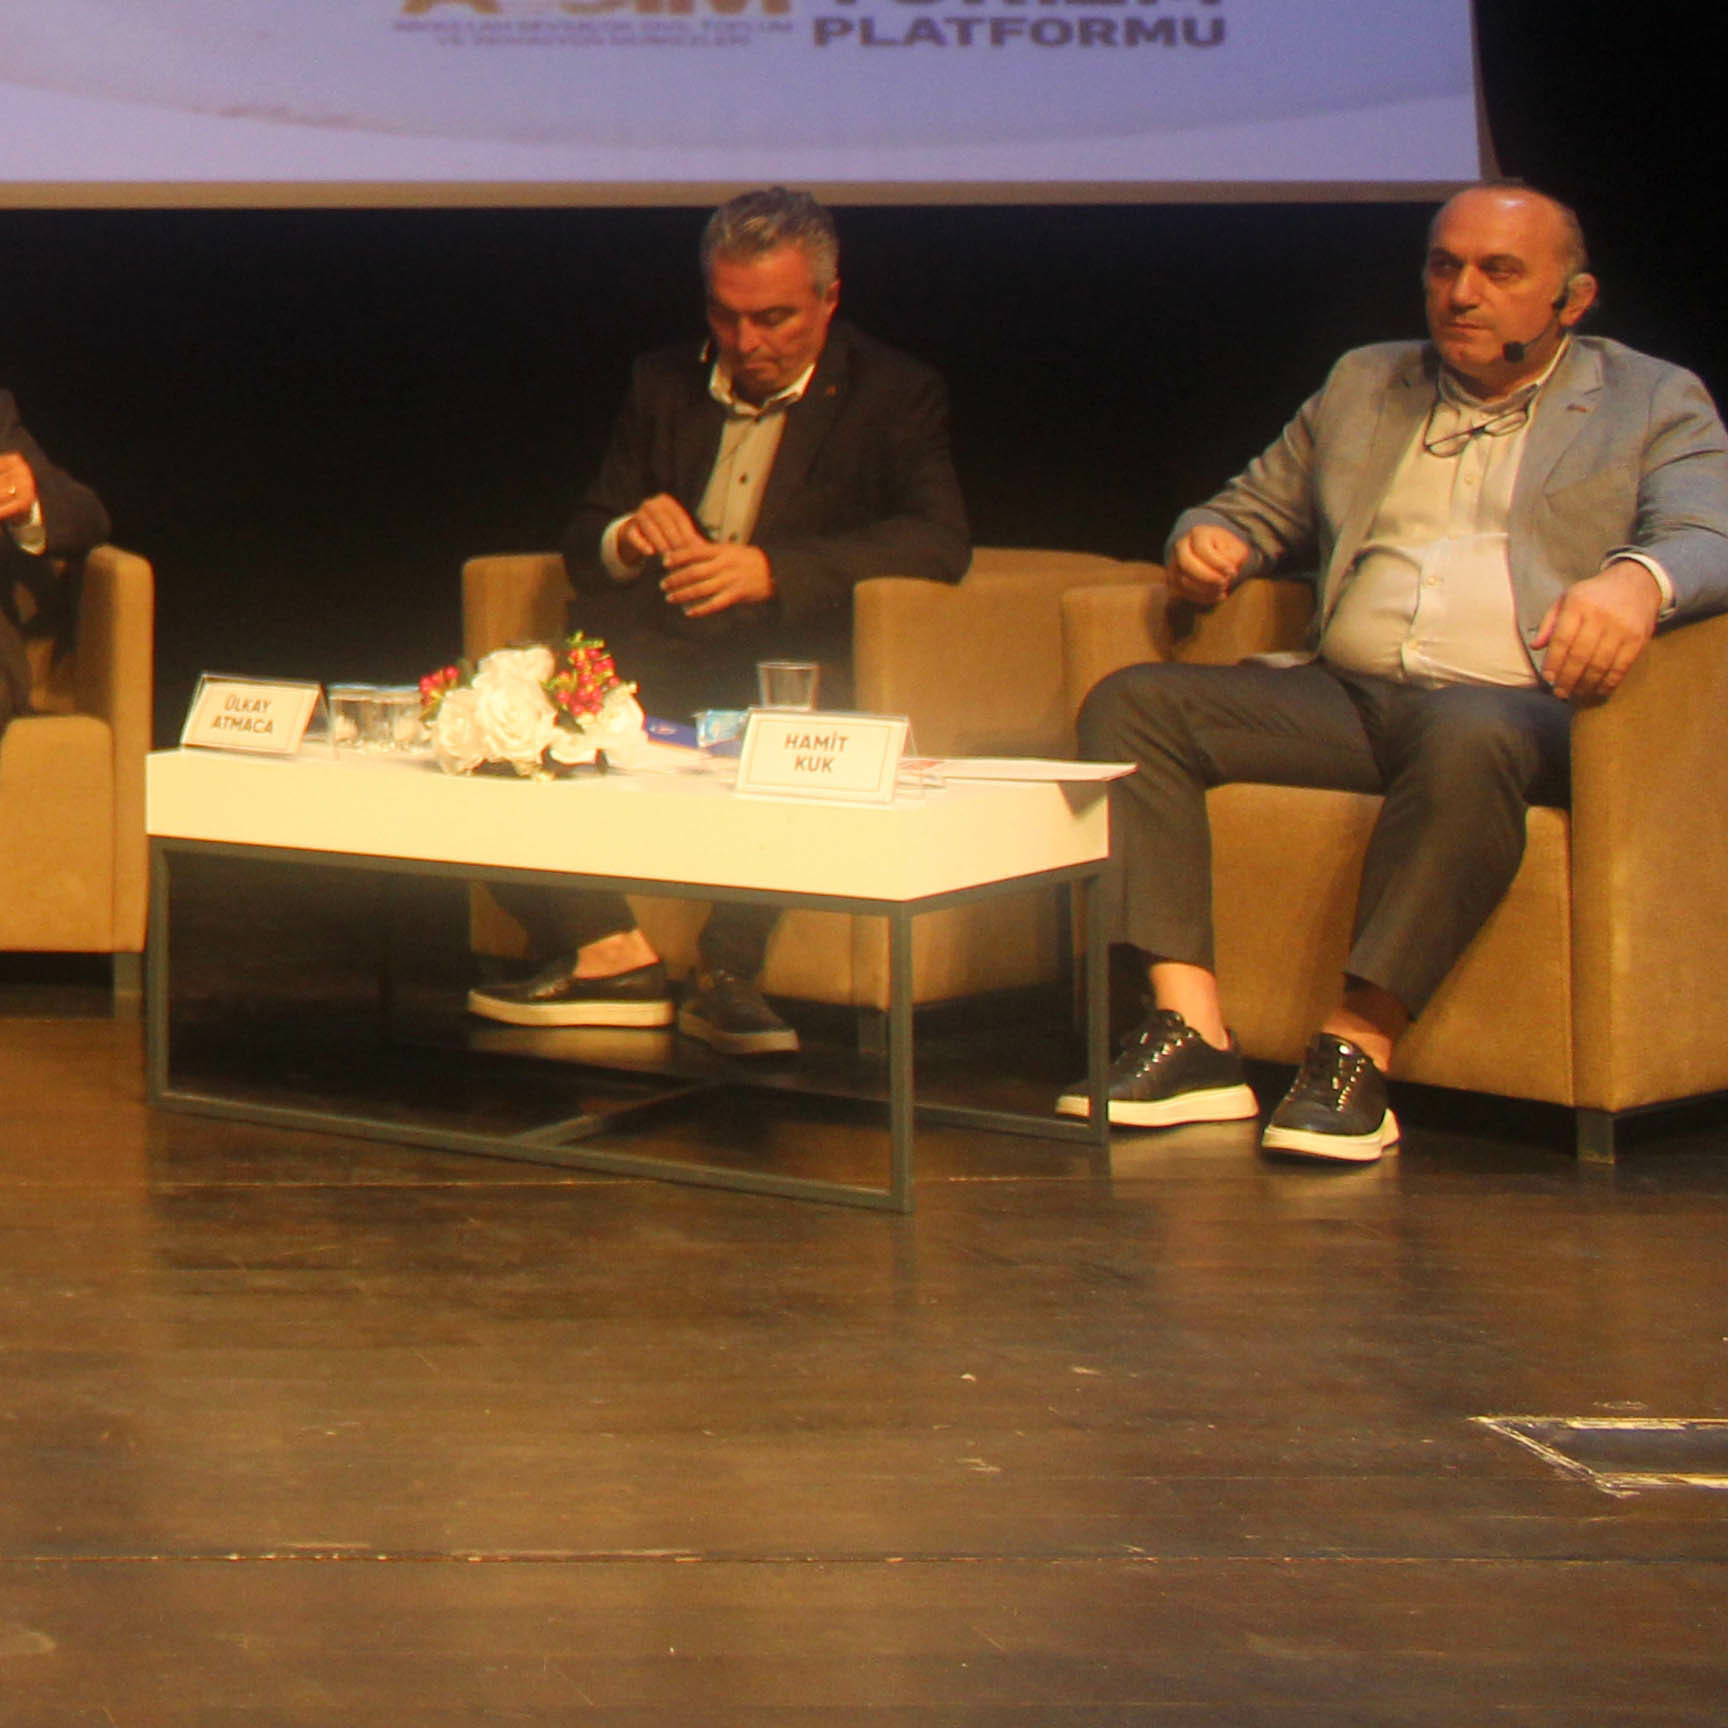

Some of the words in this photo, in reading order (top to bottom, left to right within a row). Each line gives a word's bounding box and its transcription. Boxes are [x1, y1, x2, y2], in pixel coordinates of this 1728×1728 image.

[810, 16, 1226, 50] PLATFORMU
[211, 715, 274, 734] ATMACA
[793, 755, 835, 774] KUK
